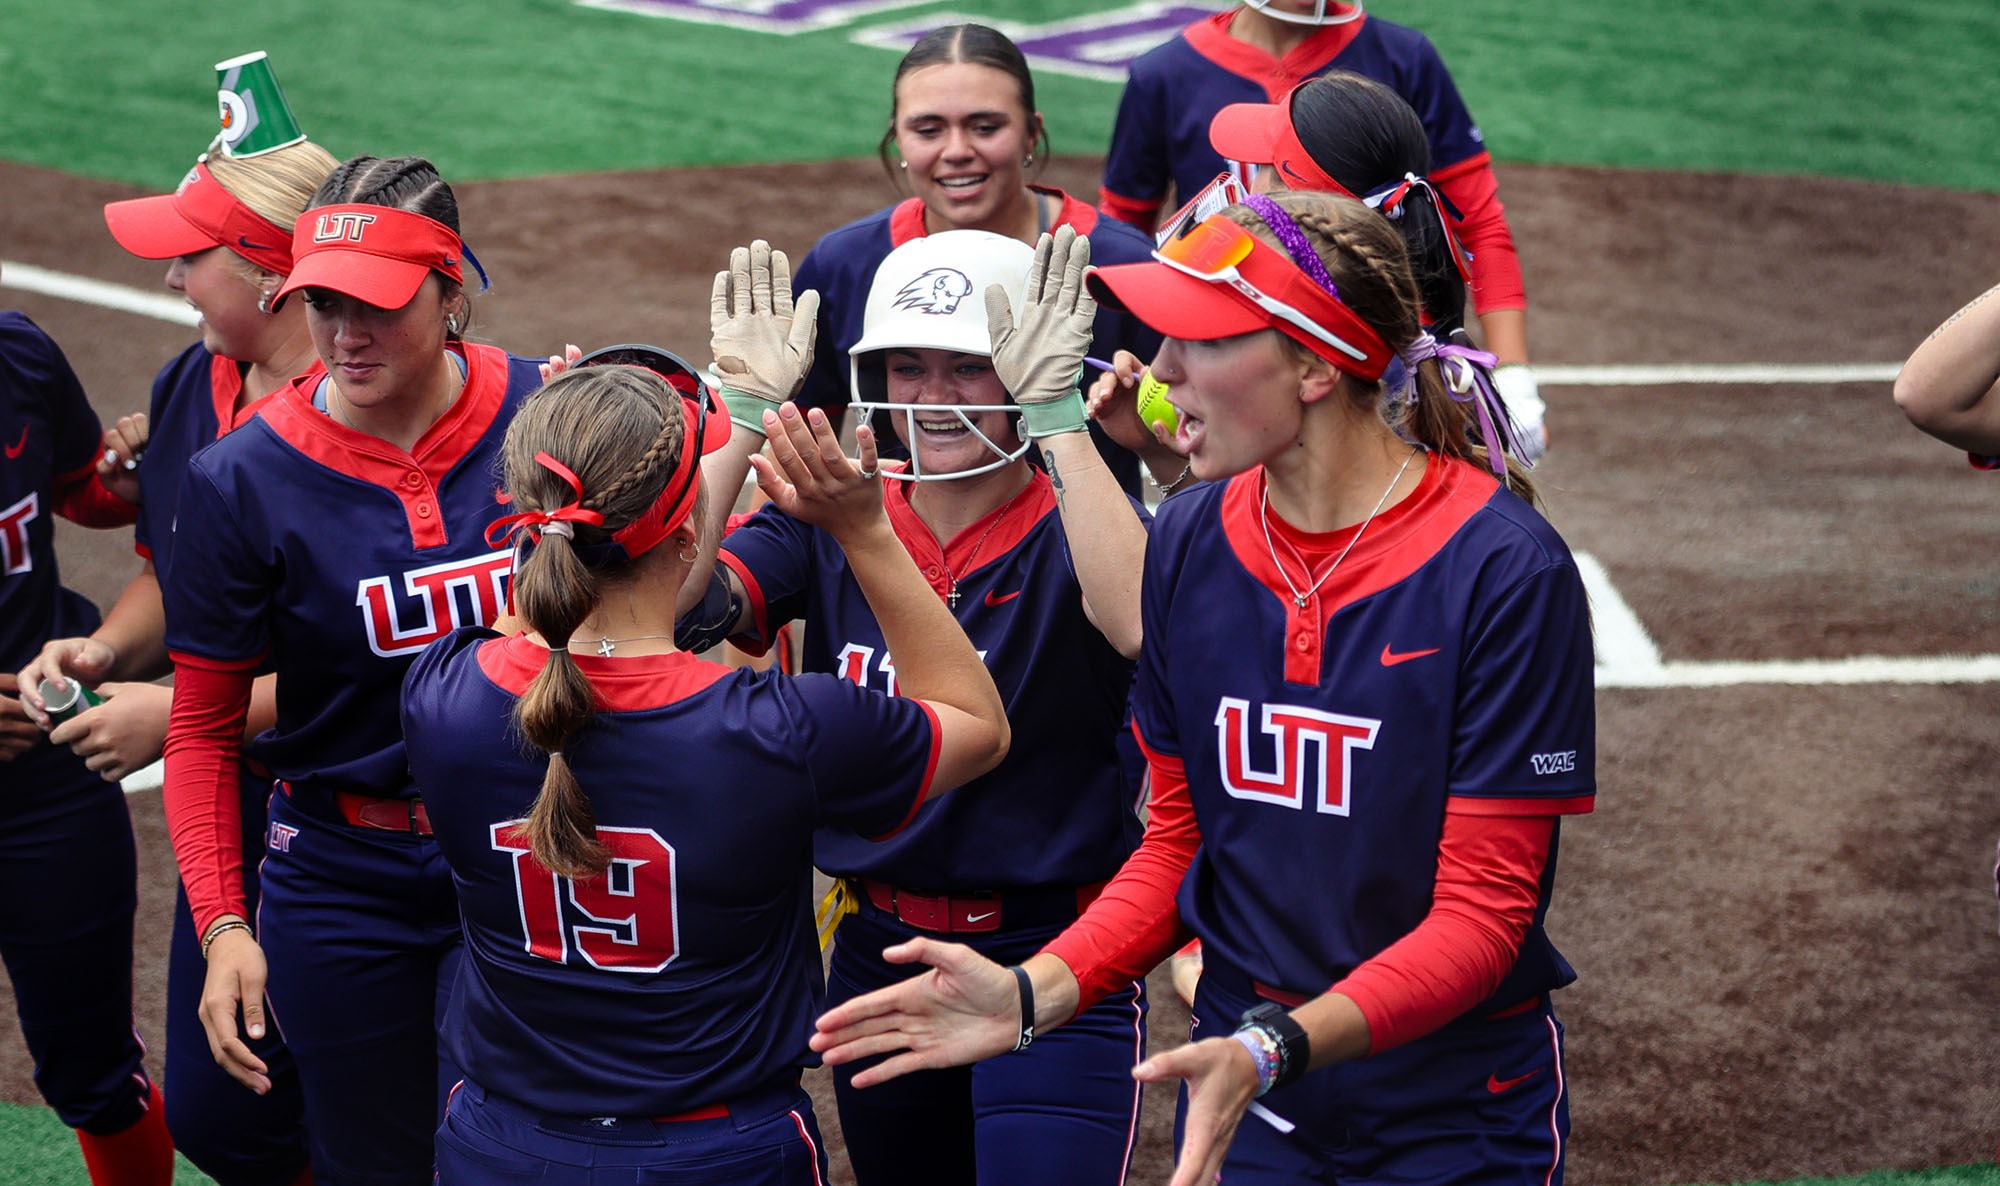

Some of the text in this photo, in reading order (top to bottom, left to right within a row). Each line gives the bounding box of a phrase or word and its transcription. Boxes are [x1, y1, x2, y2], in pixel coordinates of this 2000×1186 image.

[313, 212, 377, 243] UT
[0, 491, 39, 576] T
[356, 547, 518, 658] UT
[1214, 696, 1382, 817] UT
[1530, 750, 1577, 775] WAC
[270, 821, 300, 852] UT
[489, 818, 680, 974] 19
